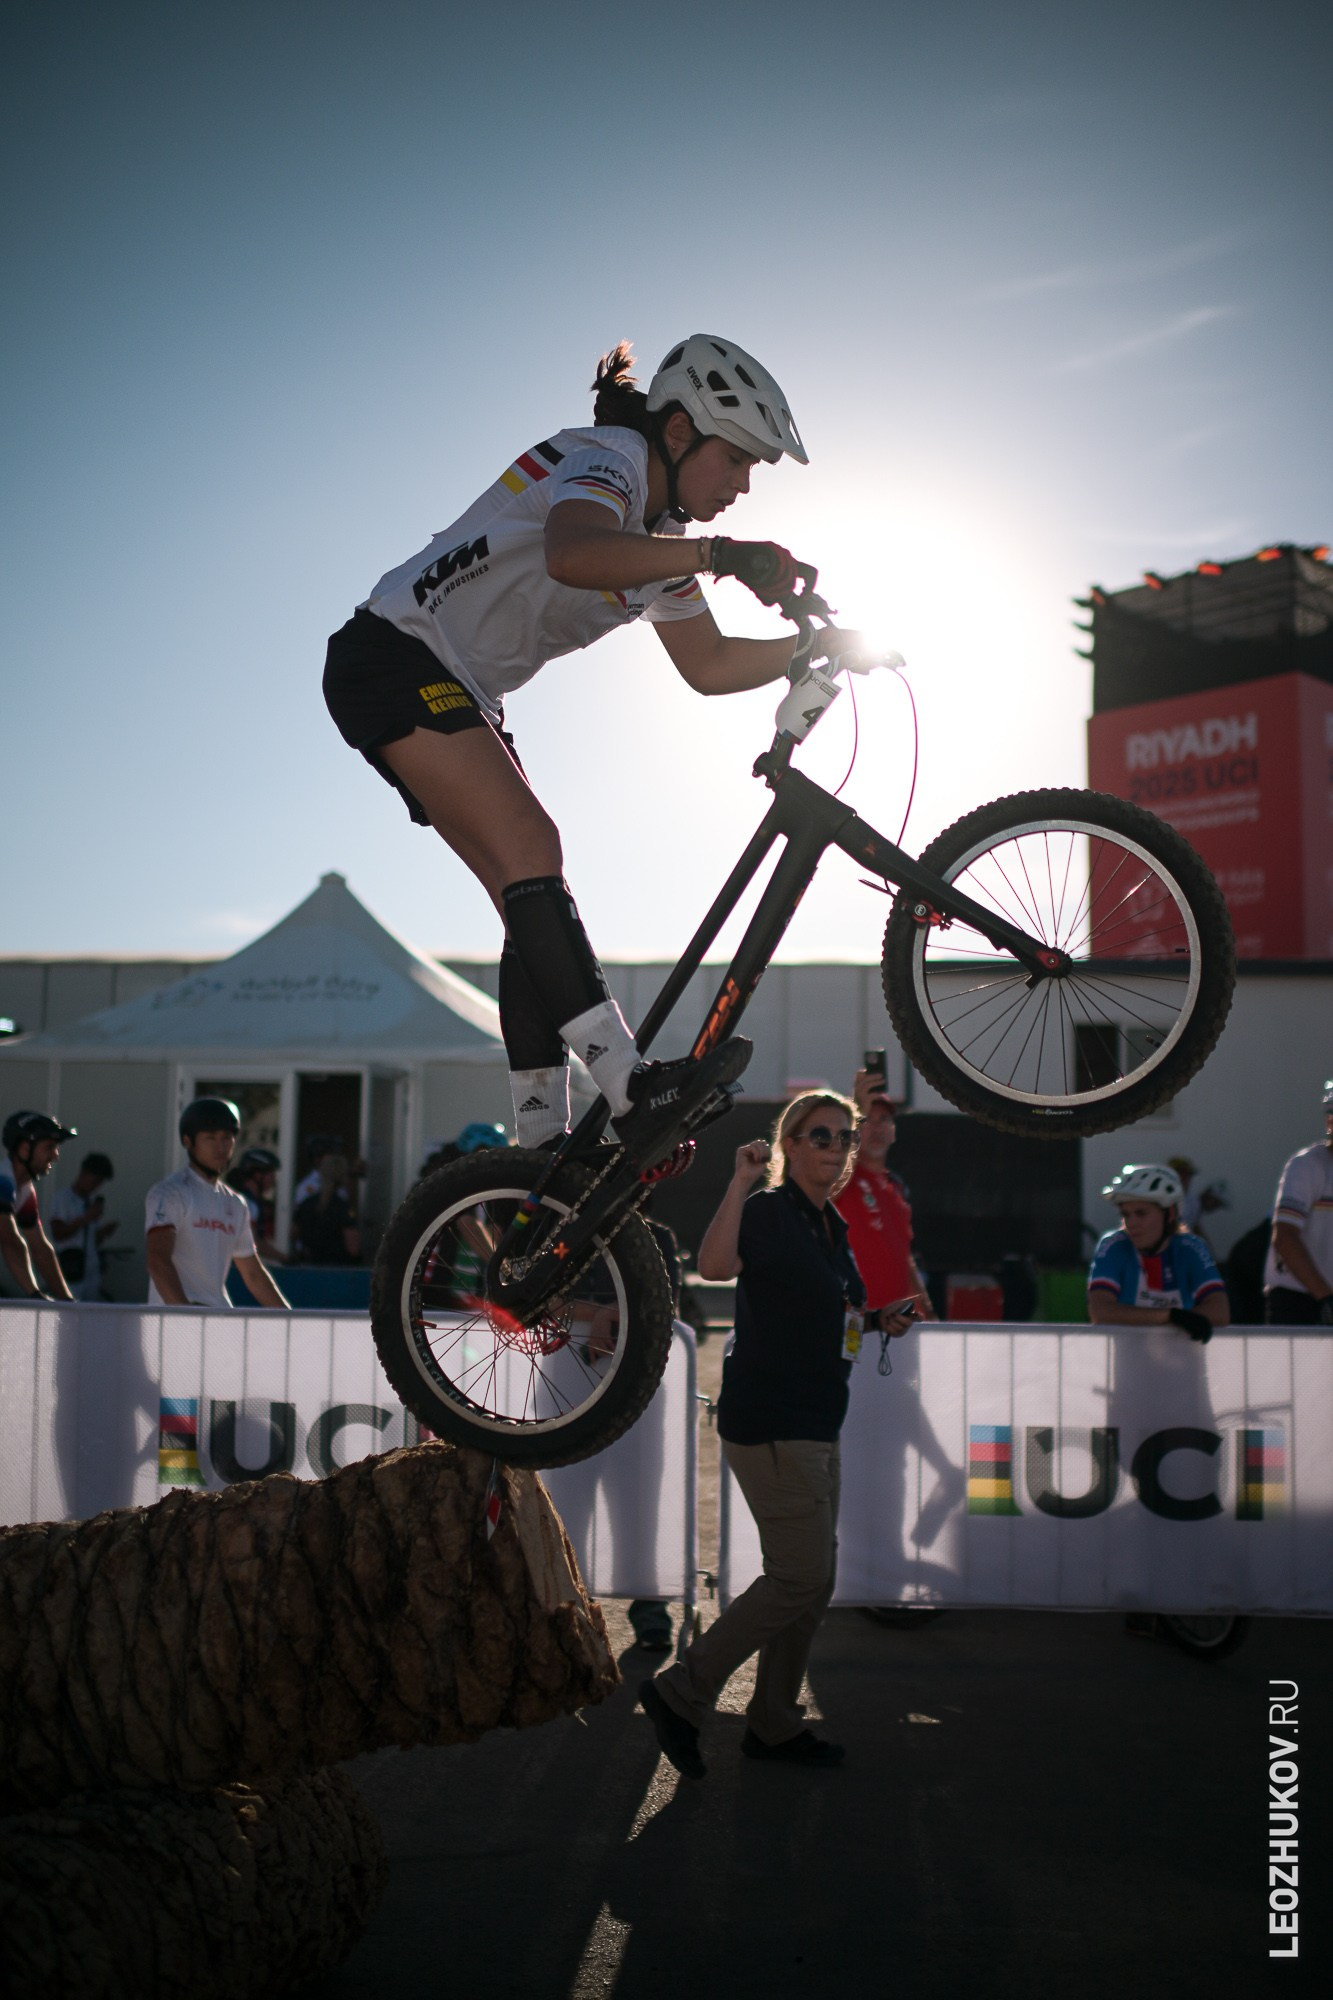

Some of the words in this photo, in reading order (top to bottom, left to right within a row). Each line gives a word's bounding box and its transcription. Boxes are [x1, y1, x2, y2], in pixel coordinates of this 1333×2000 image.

[686, 366, 704, 390] uvex
[412, 534, 490, 608] KTM
[428, 595, 443, 615] BKE
[443, 564, 489, 598] INDUSTRIES
[1125, 714, 1258, 771] RIYADH
[1205, 757, 1259, 790] UCI
[1026, 1426, 1264, 1521] UCI
